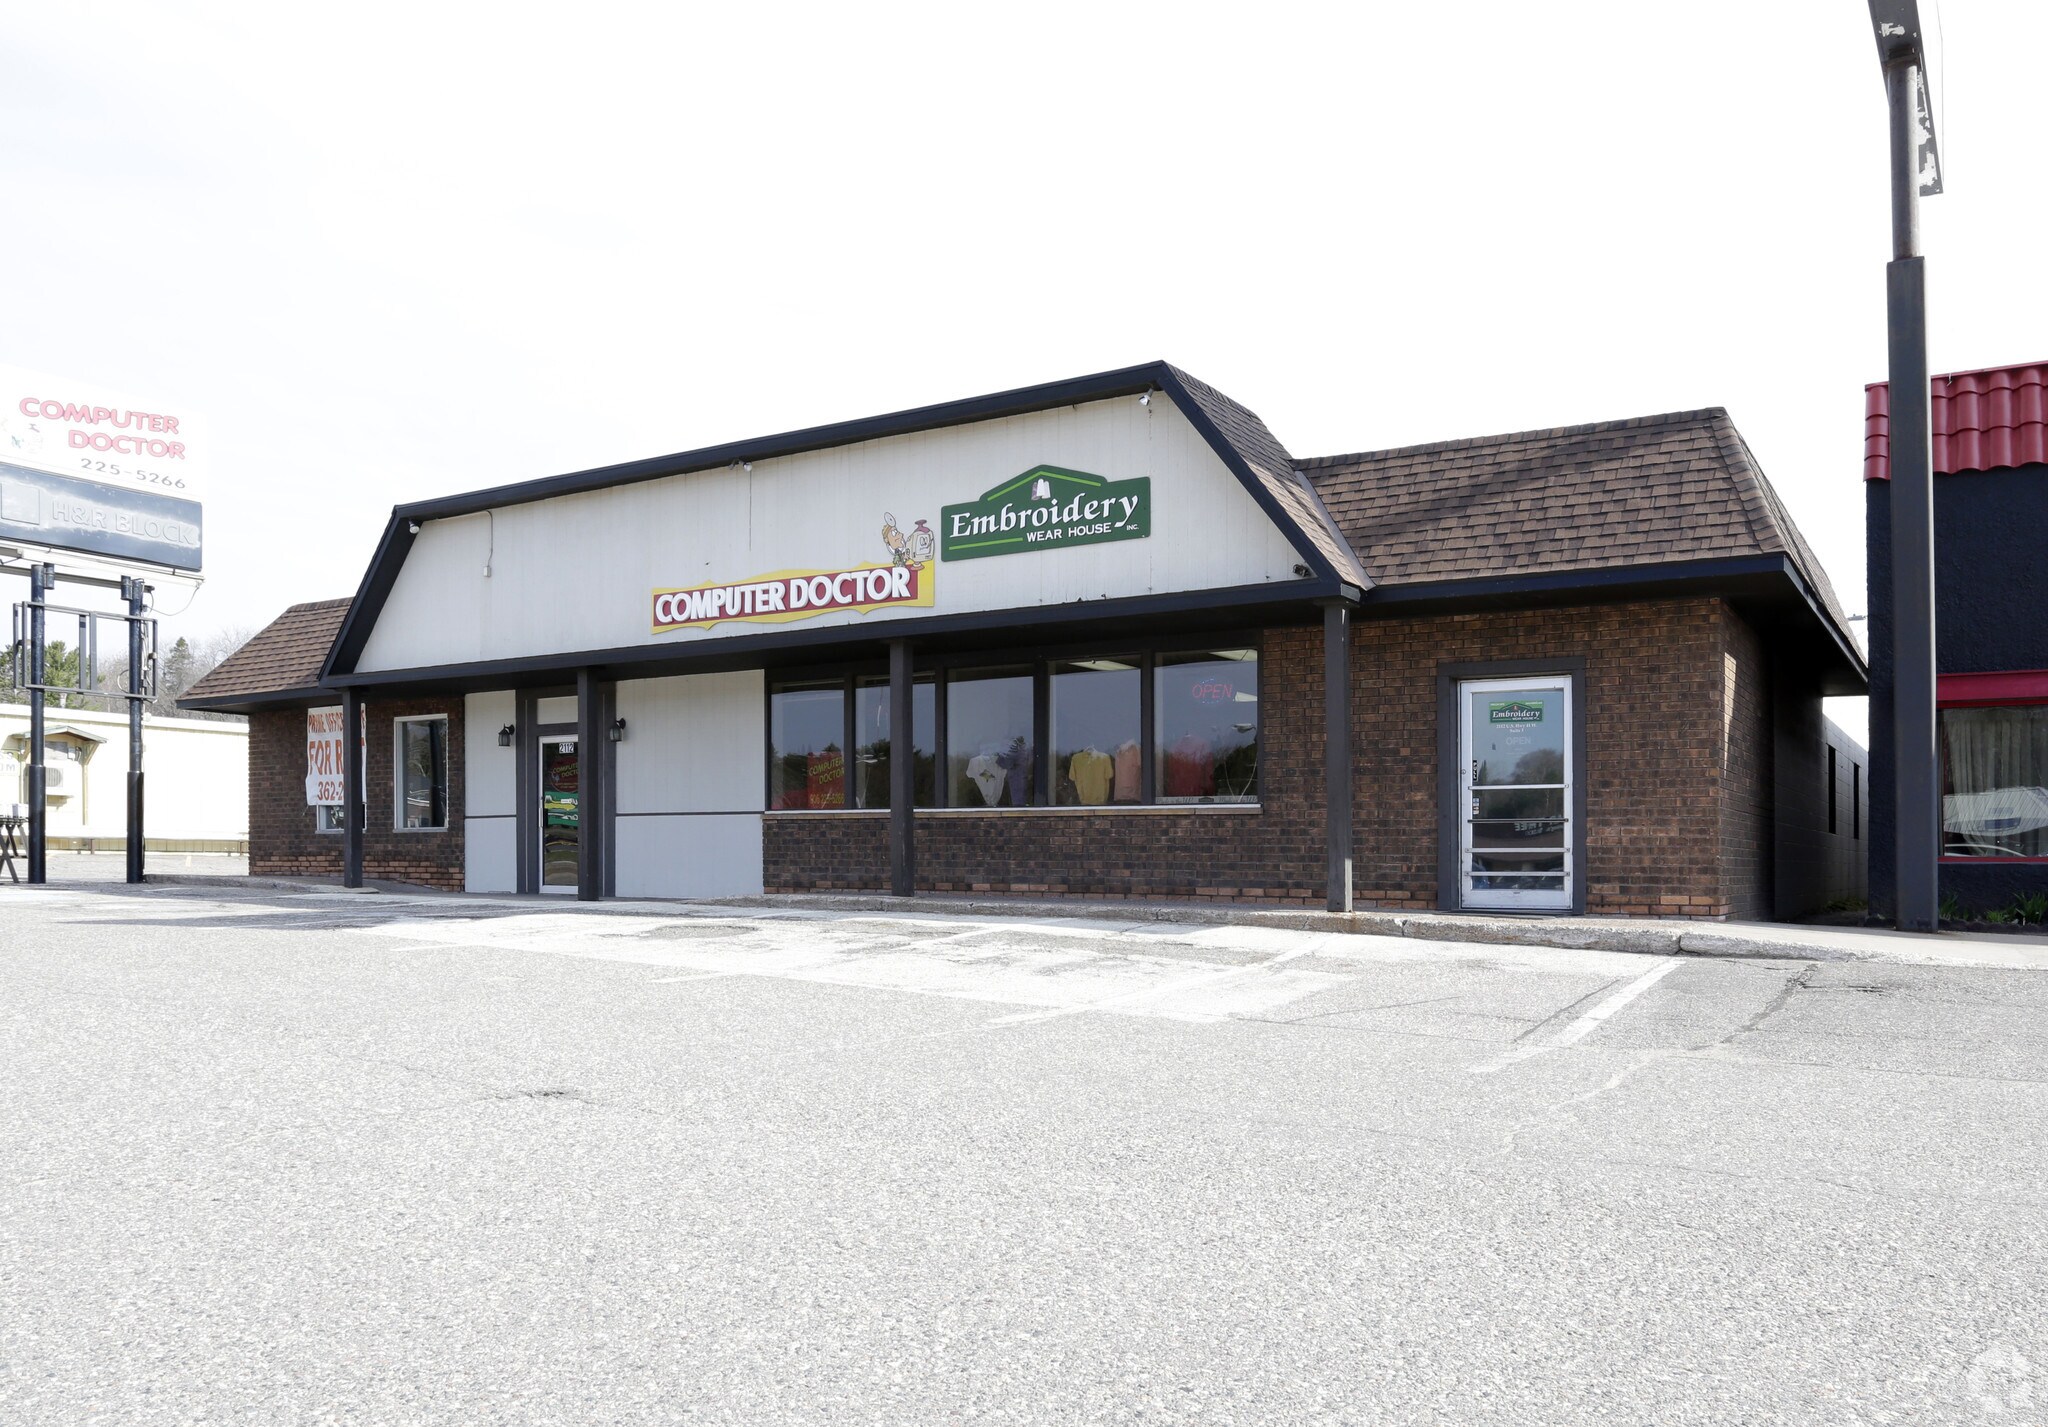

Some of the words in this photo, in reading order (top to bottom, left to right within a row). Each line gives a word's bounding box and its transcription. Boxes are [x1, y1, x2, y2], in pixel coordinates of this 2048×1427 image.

[19, 397, 180, 434] COMPUTER
[68, 429, 186, 460] DOCTOR
[80, 458, 186, 489] 225-5266
[51, 500, 107, 529] H&R
[115, 513, 193, 545] BLOCK
[949, 492, 1139, 538] Embroidery
[1026, 529, 1063, 543] WEAR
[1068, 522, 1112, 537] HOUSE
[655, 581, 786, 623] COMPUTER
[789, 567, 912, 609] DOCTOR
[1191, 684, 1233, 700] OPEN
[1492, 709, 1540, 720] Embroidery
[309, 740, 333, 775] FOR
[560, 743, 574, 753] 2112
